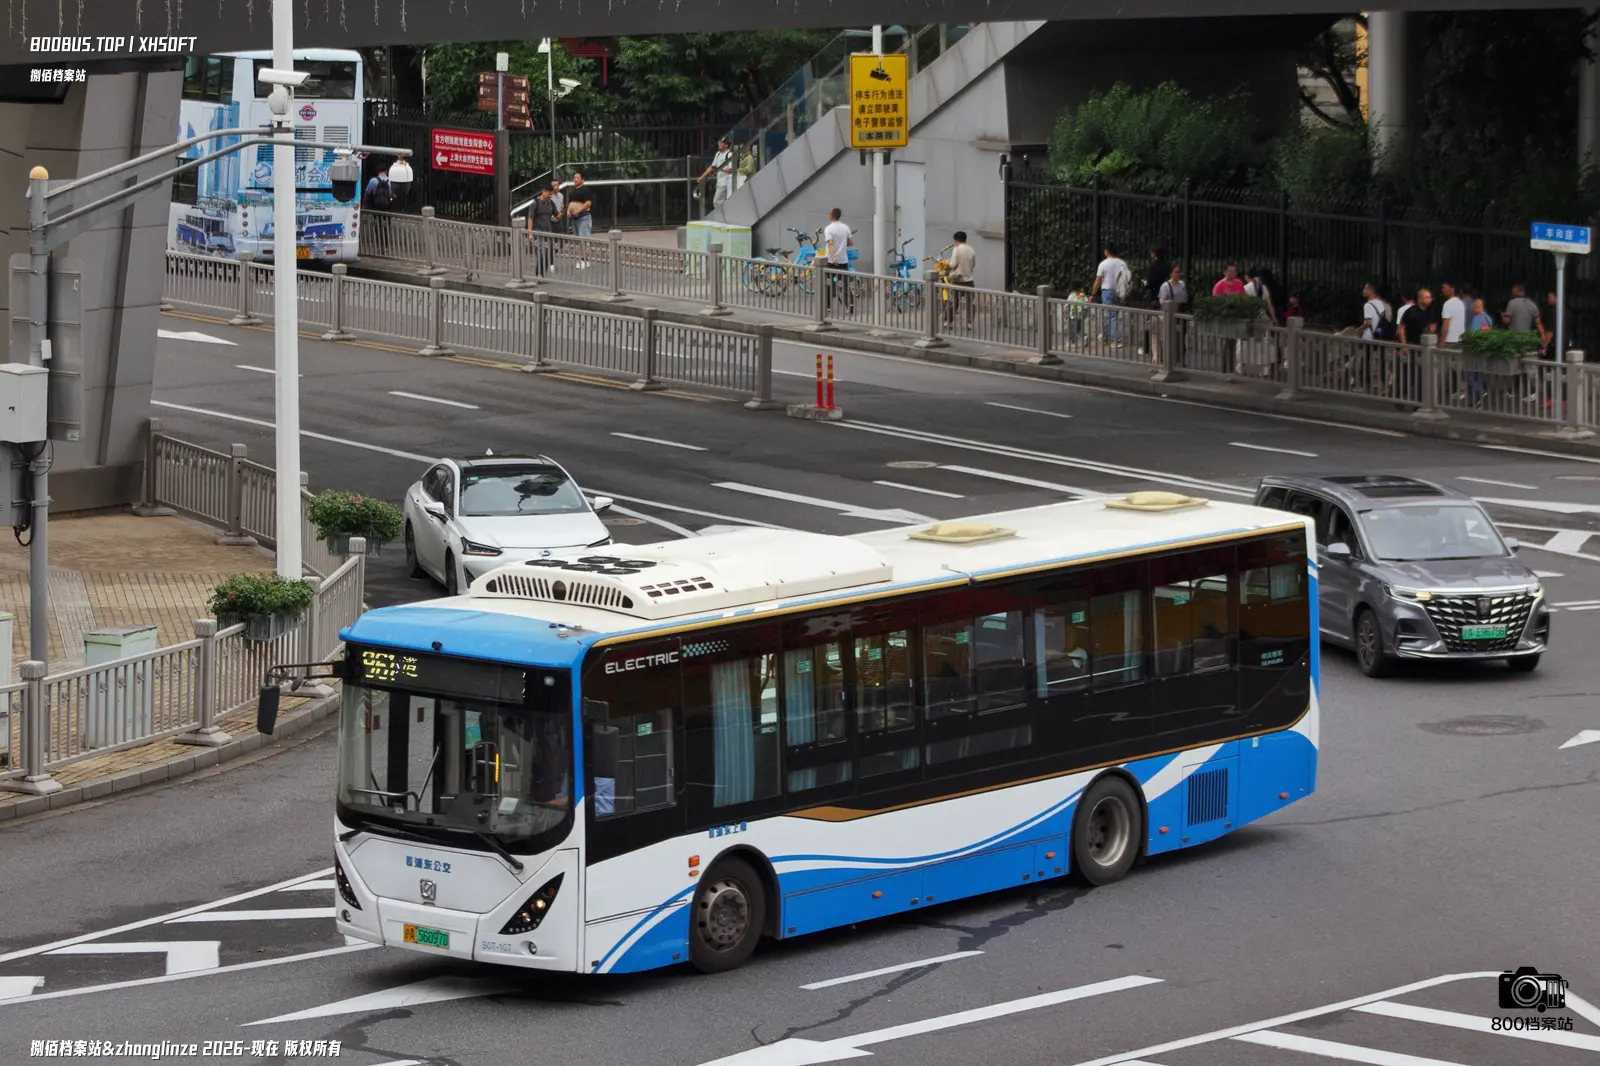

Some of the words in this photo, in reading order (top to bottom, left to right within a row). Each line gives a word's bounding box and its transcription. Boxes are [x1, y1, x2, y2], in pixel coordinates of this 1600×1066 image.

[855, 90, 903, 100] 停车行为违法
[865, 131, 893, 141] 本路段
[604, 651, 680, 675] ELECTRIC
[414, 857, 452, 873] 浦东公交
